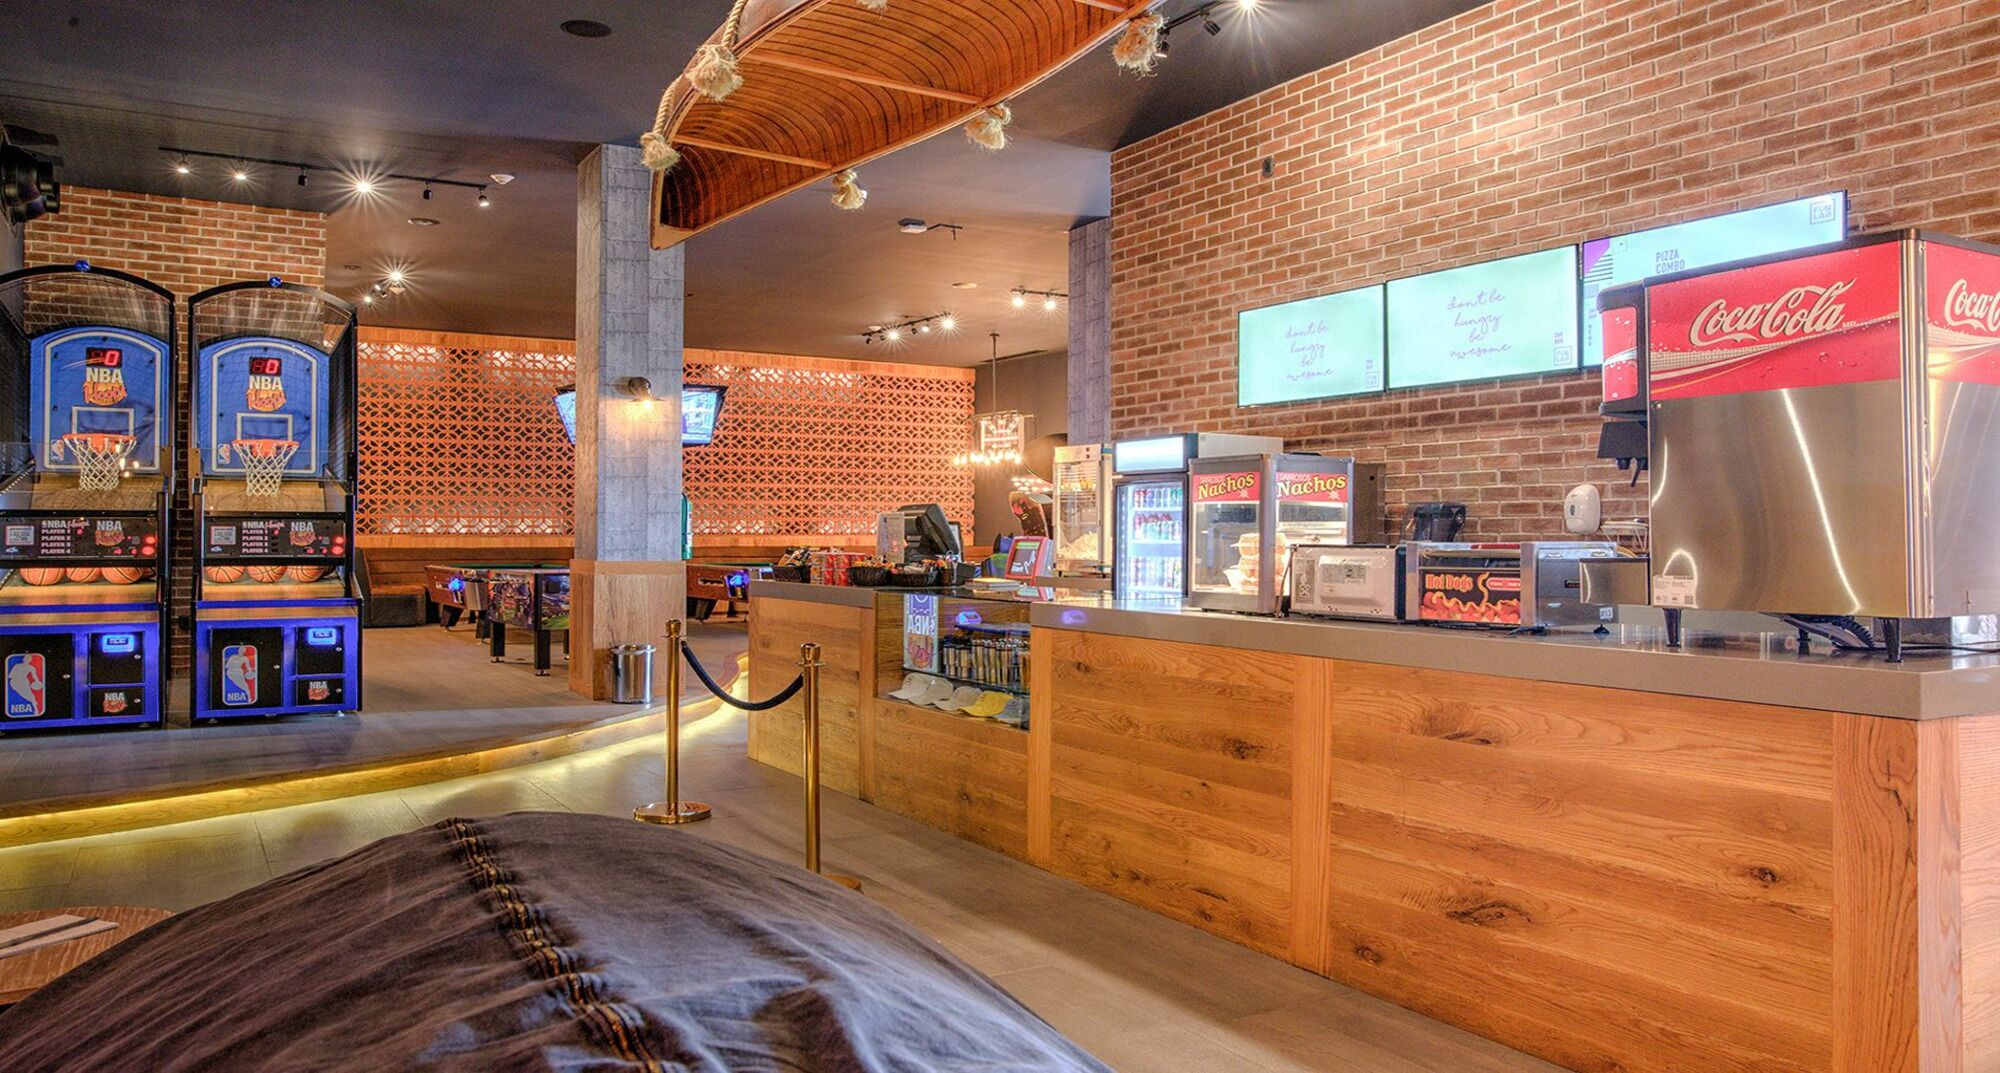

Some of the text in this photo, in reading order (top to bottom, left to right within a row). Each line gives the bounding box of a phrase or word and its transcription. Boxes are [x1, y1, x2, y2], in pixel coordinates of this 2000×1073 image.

[1655, 249, 1680, 262] PIZZA
[1655, 260, 1685, 274] COMBO
[1488, 288, 1505, 304] be
[1689, 277, 1857, 347] Coca-Cola
[1454, 312, 1502, 335] hungry
[1468, 328, 1484, 343] be
[1449, 343, 1512, 360] awesome
[85, 368, 124, 383] NBA
[249, 375, 284, 390] NBA
[1198, 473, 1256, 500] Nachos
[1276, 474, 1347, 498] Nachos
[47, 520, 67, 529] NBA
[96, 520, 123, 531] NBA
[247, 521, 265, 529] NBA
[291, 521, 315, 532] NBA
[1425, 574, 1444, 590] Hot
[1445, 575, 1474, 593] Dogs
[309, 681, 328, 690] NBA
[104, 692, 125, 701] NBA
[227, 692, 247, 702] NBA
[11, 704, 33, 714] NBA
